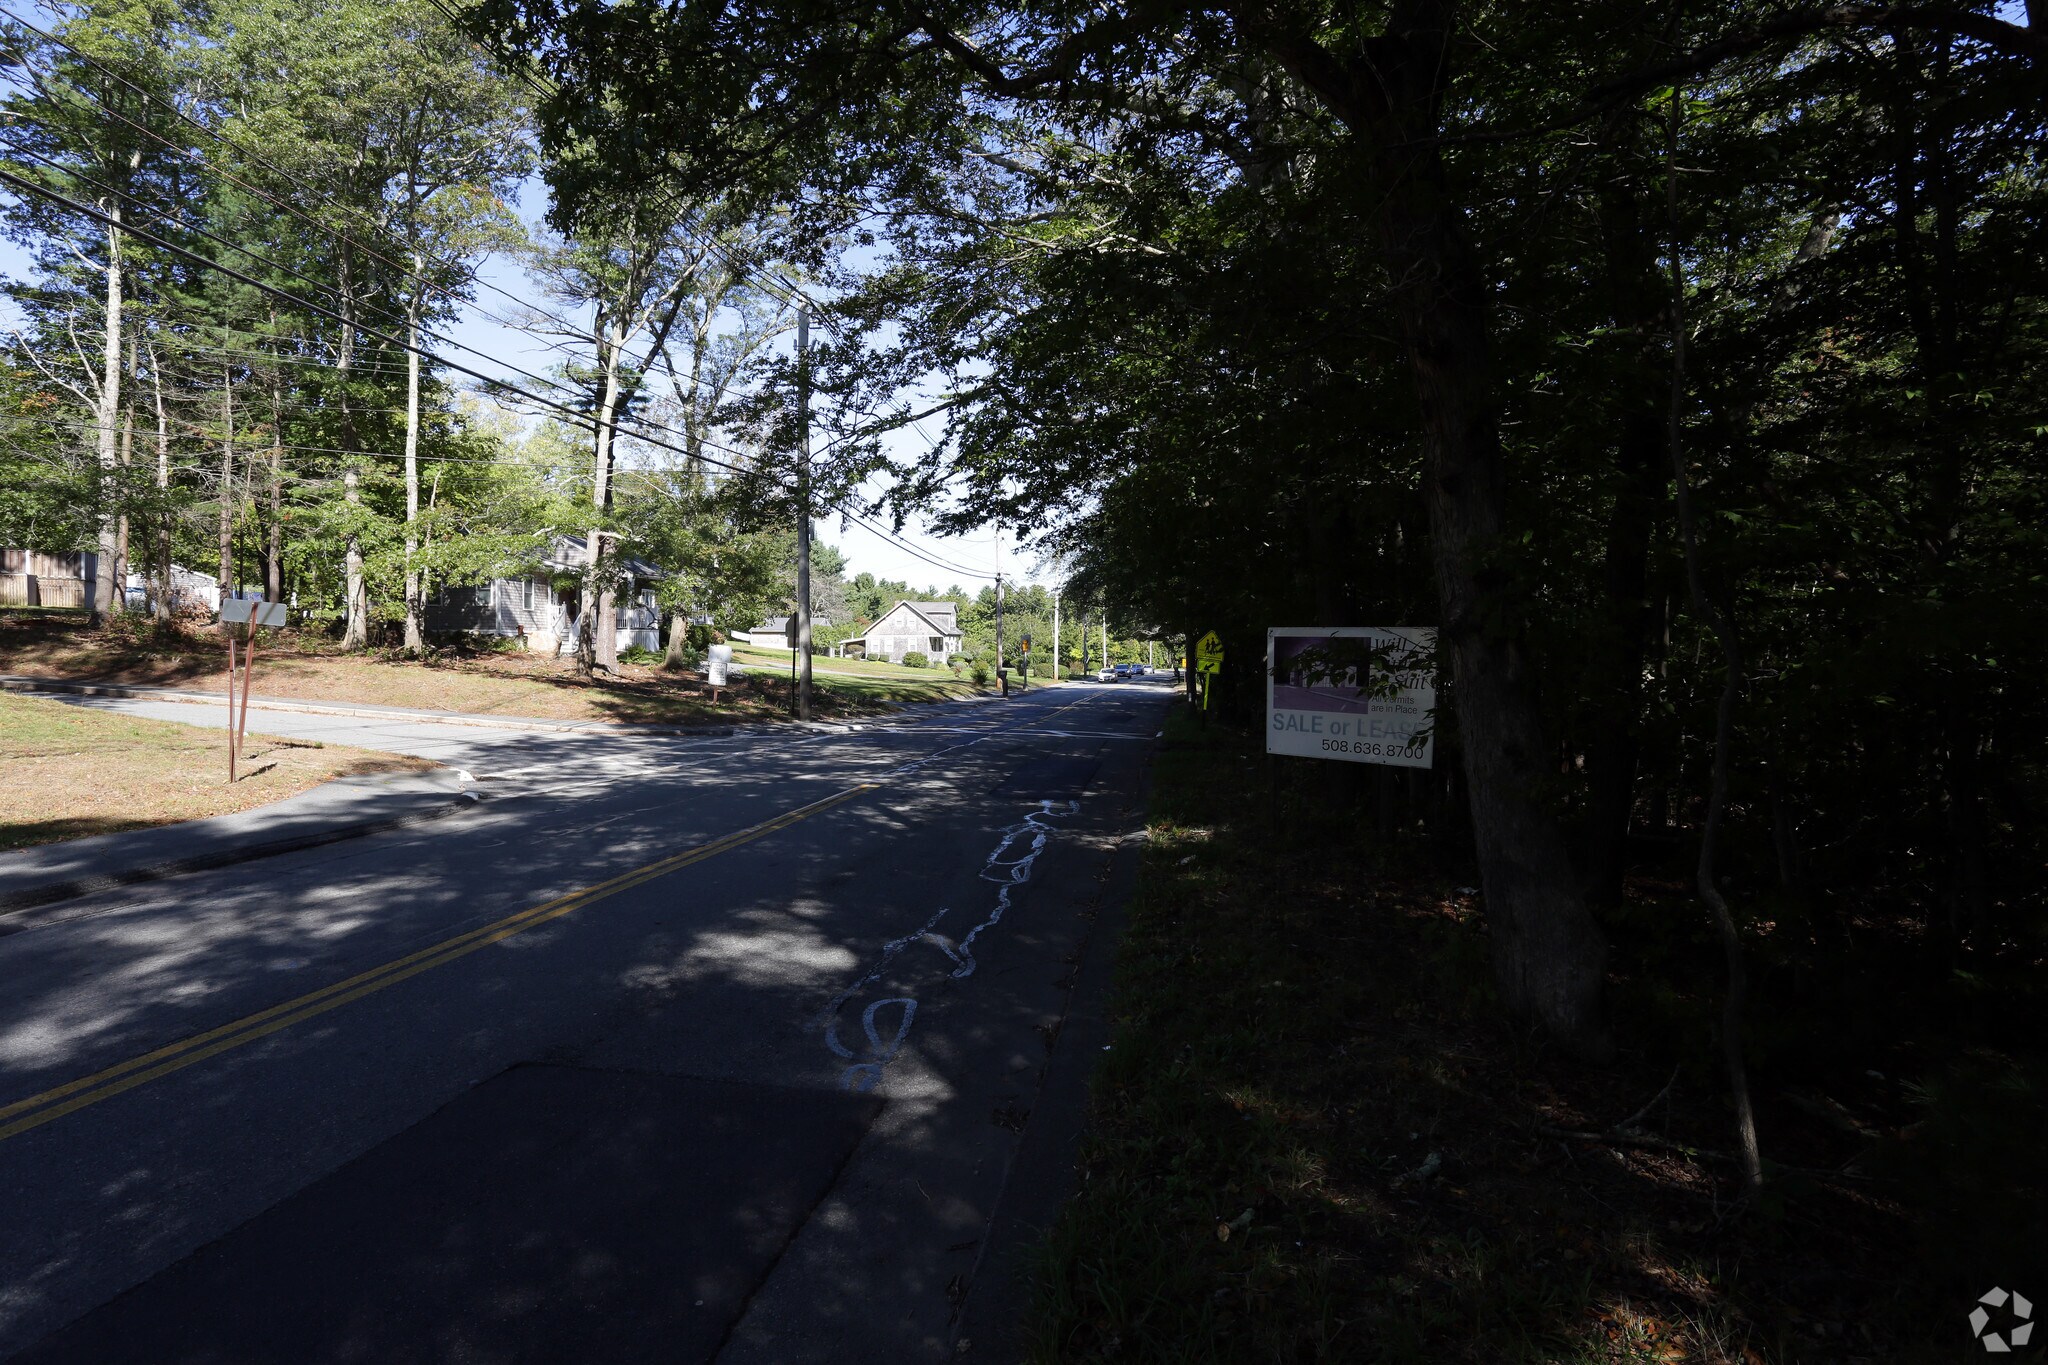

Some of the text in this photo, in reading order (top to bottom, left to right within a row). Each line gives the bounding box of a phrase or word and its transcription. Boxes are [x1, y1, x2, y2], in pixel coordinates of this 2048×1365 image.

[1396, 705, 1418, 714] Place
[1273, 712, 1421, 741] SALE or LEAS
[1322, 739, 1423, 759] 508.636.8700
